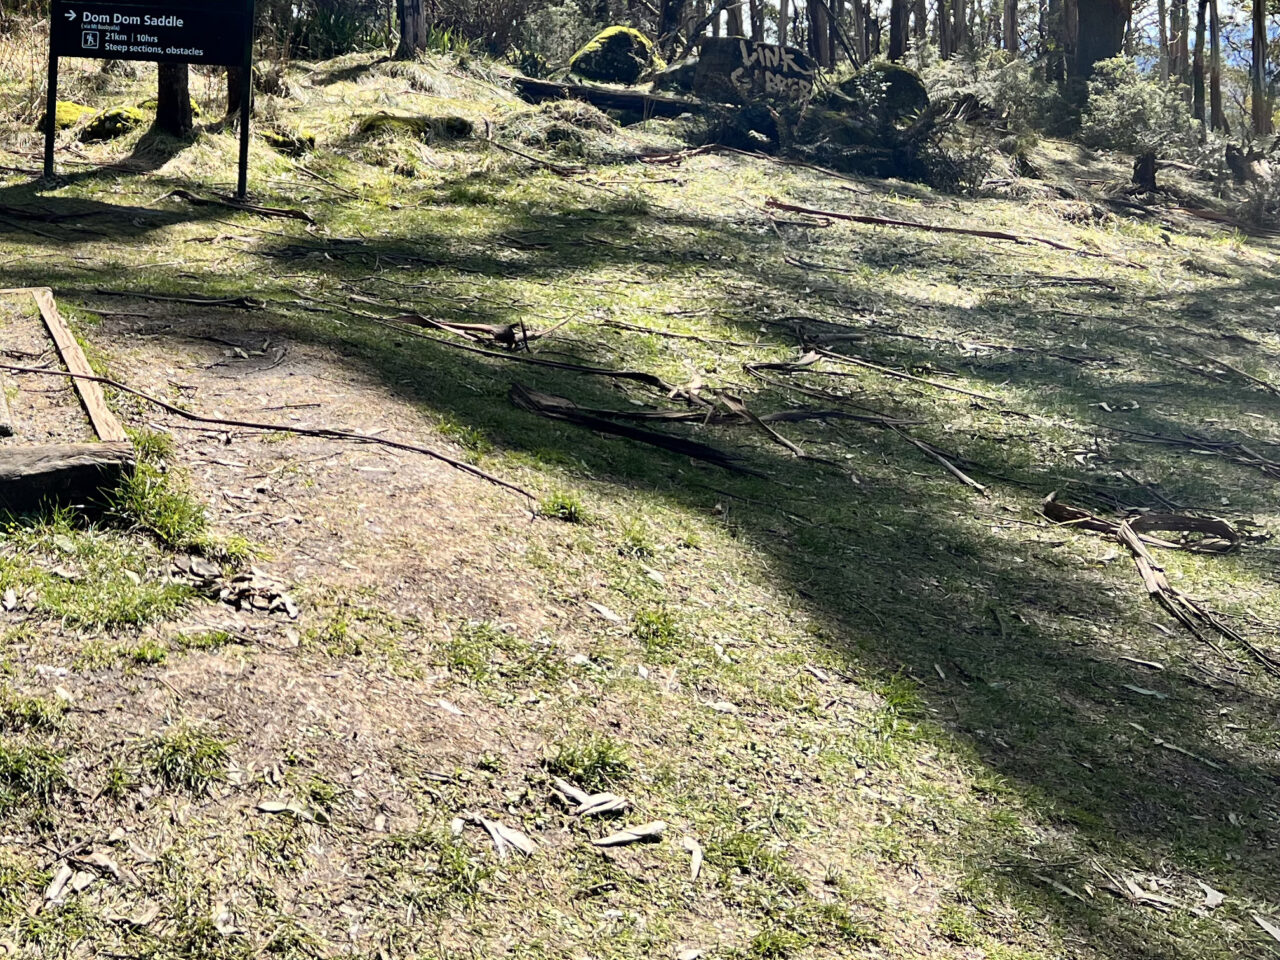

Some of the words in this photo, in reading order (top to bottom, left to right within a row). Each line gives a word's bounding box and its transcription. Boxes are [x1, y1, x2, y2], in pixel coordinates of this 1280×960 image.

[82, 12, 110, 23] Dom
[113, 13, 140, 25] Dom
[144, 14, 184, 27] Saddle
[105, 32, 127, 41] 21km
[136, 34, 158, 43] 10hrs
[105, 43, 128, 52] Steep
[129, 44, 164, 54] sections,
[166, 46, 204, 56] obstacles
